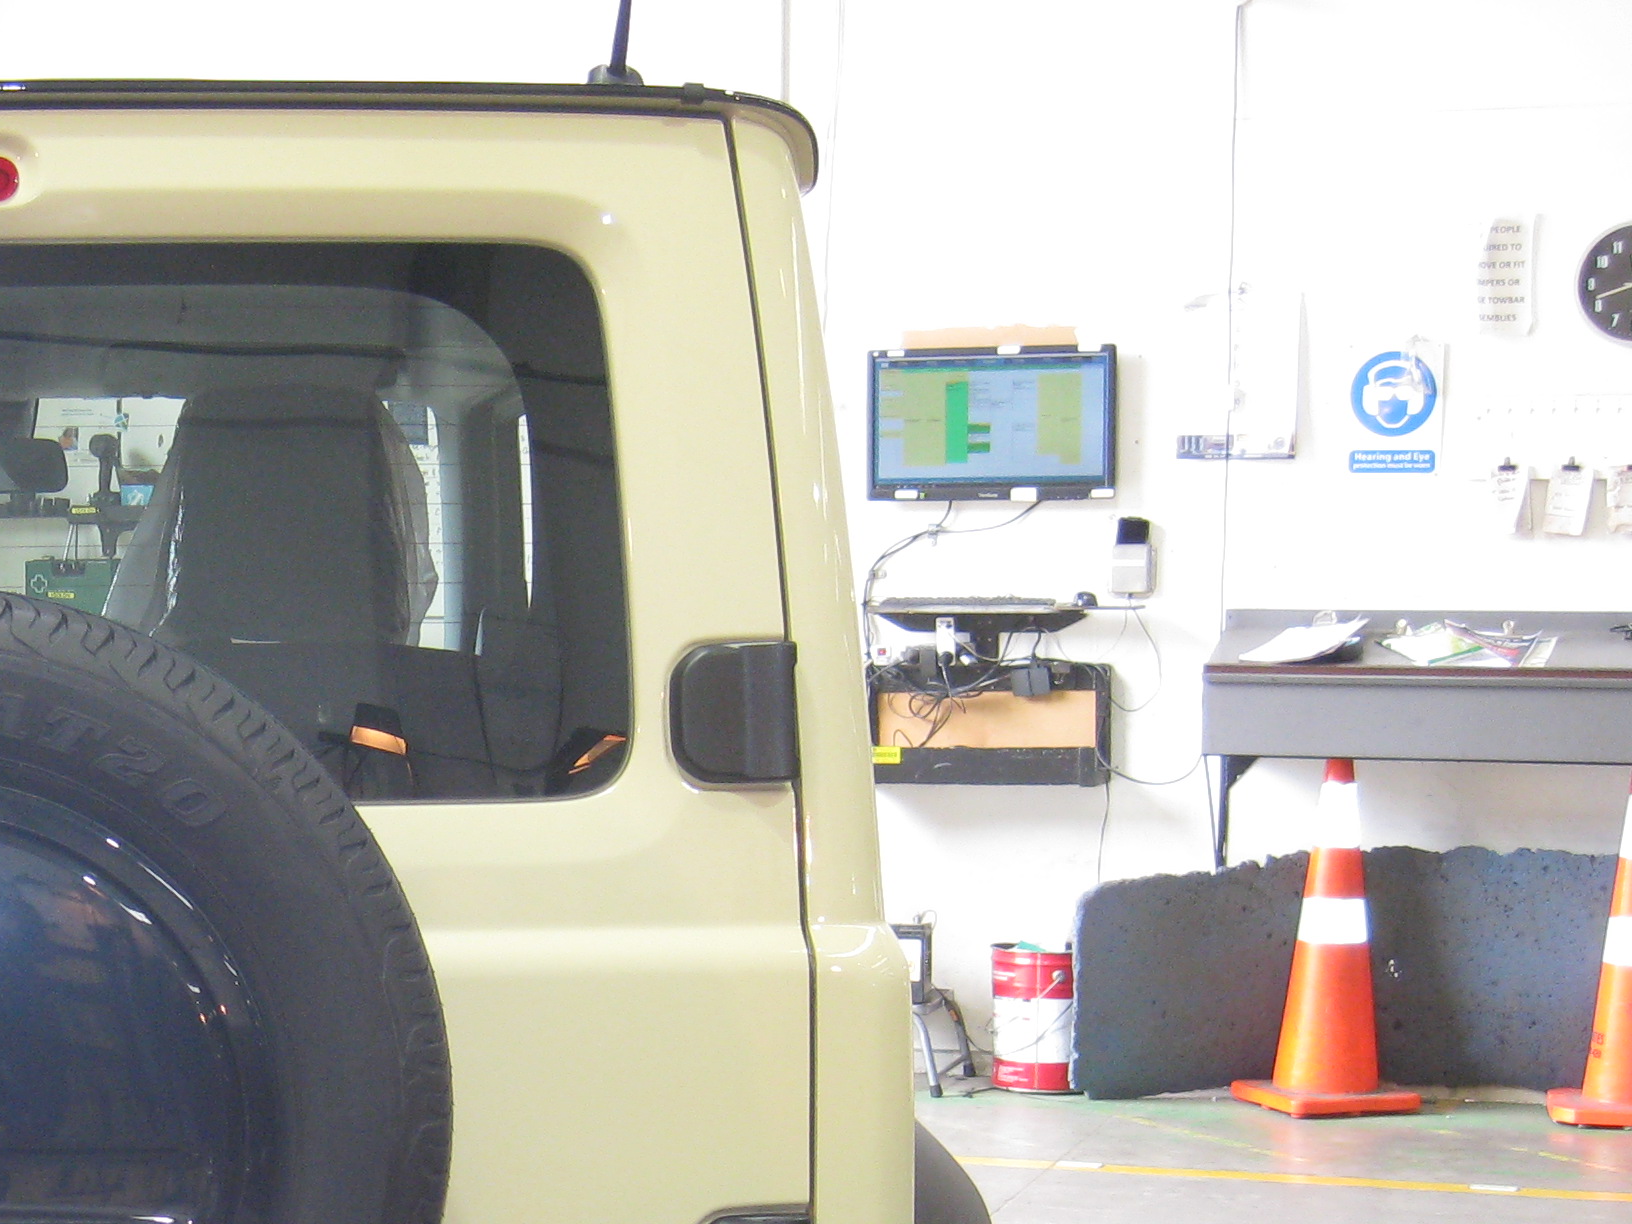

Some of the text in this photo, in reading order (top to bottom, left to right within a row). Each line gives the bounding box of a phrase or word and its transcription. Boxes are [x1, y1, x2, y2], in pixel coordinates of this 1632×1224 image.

[1612, 241, 1623, 254] 11
[1596, 255, 1609, 268] 10
[1611, 313, 1620, 328] 7
[1354, 452, 1430, 463] Hearing and Eye
